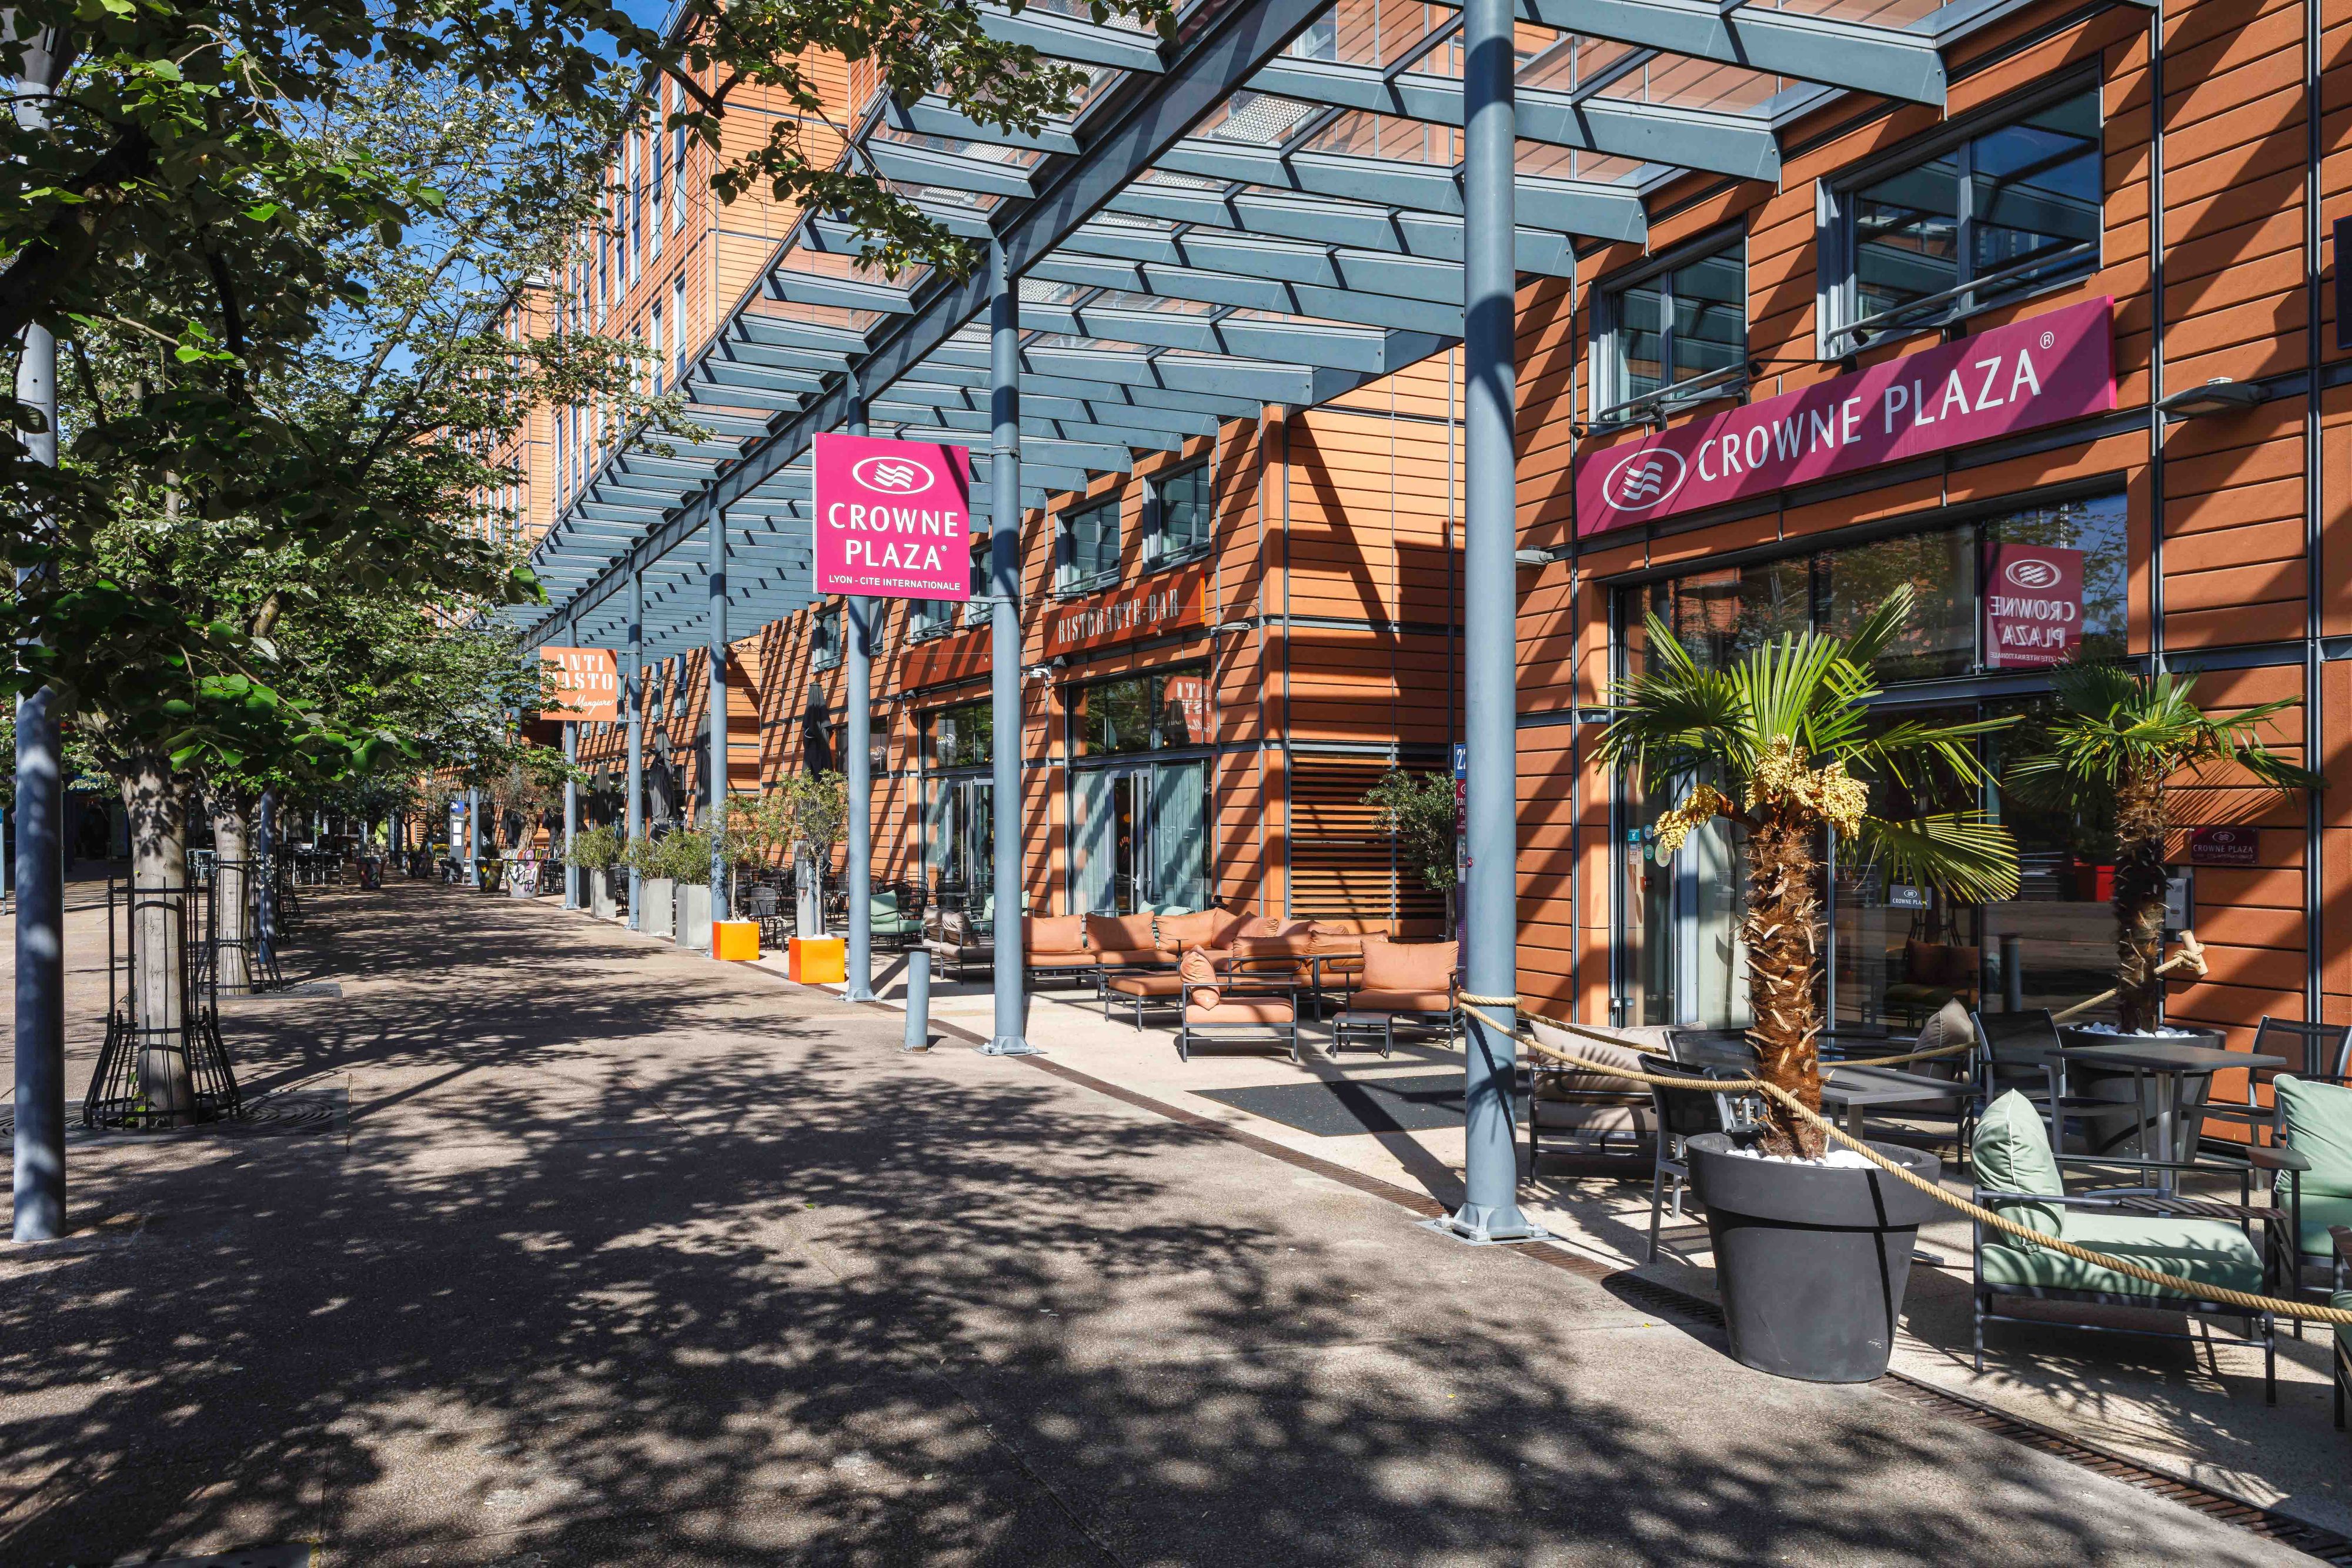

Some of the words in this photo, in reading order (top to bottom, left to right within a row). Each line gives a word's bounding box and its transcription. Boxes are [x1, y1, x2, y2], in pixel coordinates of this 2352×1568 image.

[1698, 396, 1862, 482] CROWNE
[828, 502, 958, 537] CROWNE
[828, 575, 853, 584] LYON
[860, 577, 880, 586] CITE
[883, 578, 961, 591] INTERNATIONALE
[557, 653, 604, 672] ANTI
[1456, 748, 1466, 770] 2
[2193, 844, 2226, 852] CROWNE
[2228, 845, 2253, 854] PLAZA
